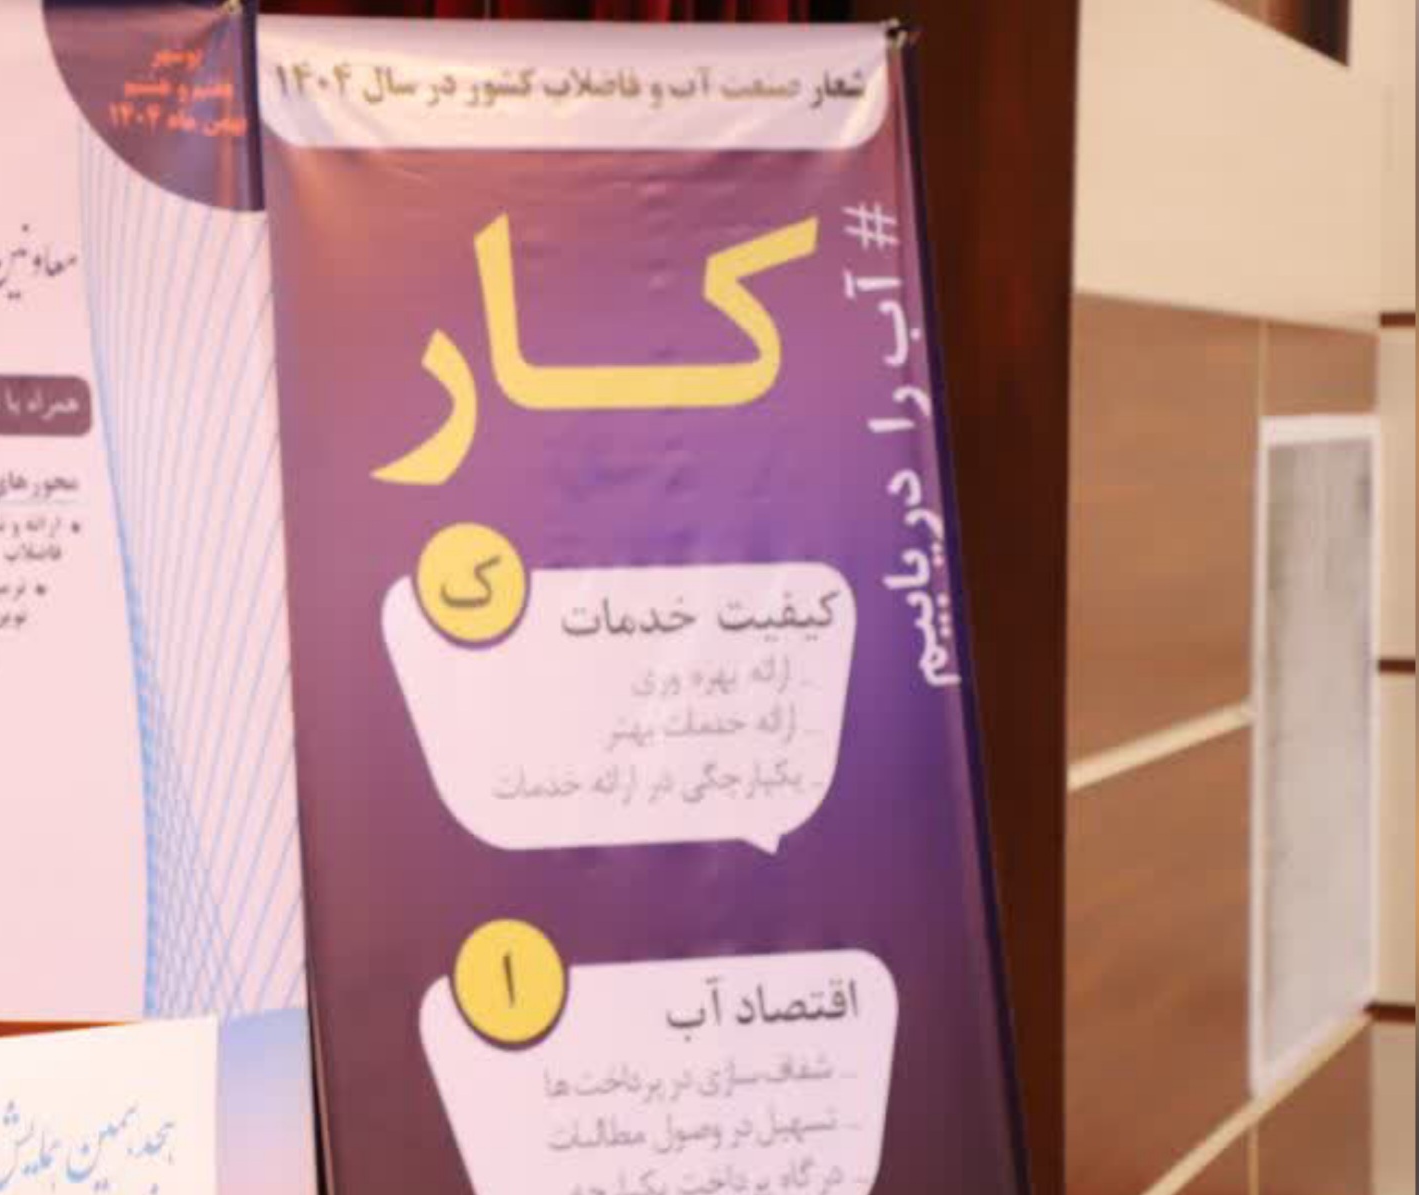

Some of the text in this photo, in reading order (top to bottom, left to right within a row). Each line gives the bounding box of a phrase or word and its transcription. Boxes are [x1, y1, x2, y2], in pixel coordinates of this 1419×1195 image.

[276, 63, 867, 110] شعار صنعت آب و فاضلاب کشور در سال ۱۴۰۴
[370, 212, 819, 486] کار
[26, 383, 80, 420] همراه
[868, 385, 933, 434] را
[440, 556, 501, 609] ک
[884, 468, 962, 688] دریابیم
[561, 591, 840, 643] کیفیت خدمات
[492, 766, 580, 800] خدمات
[666, 976, 861, 1042] اقتصاد آب
